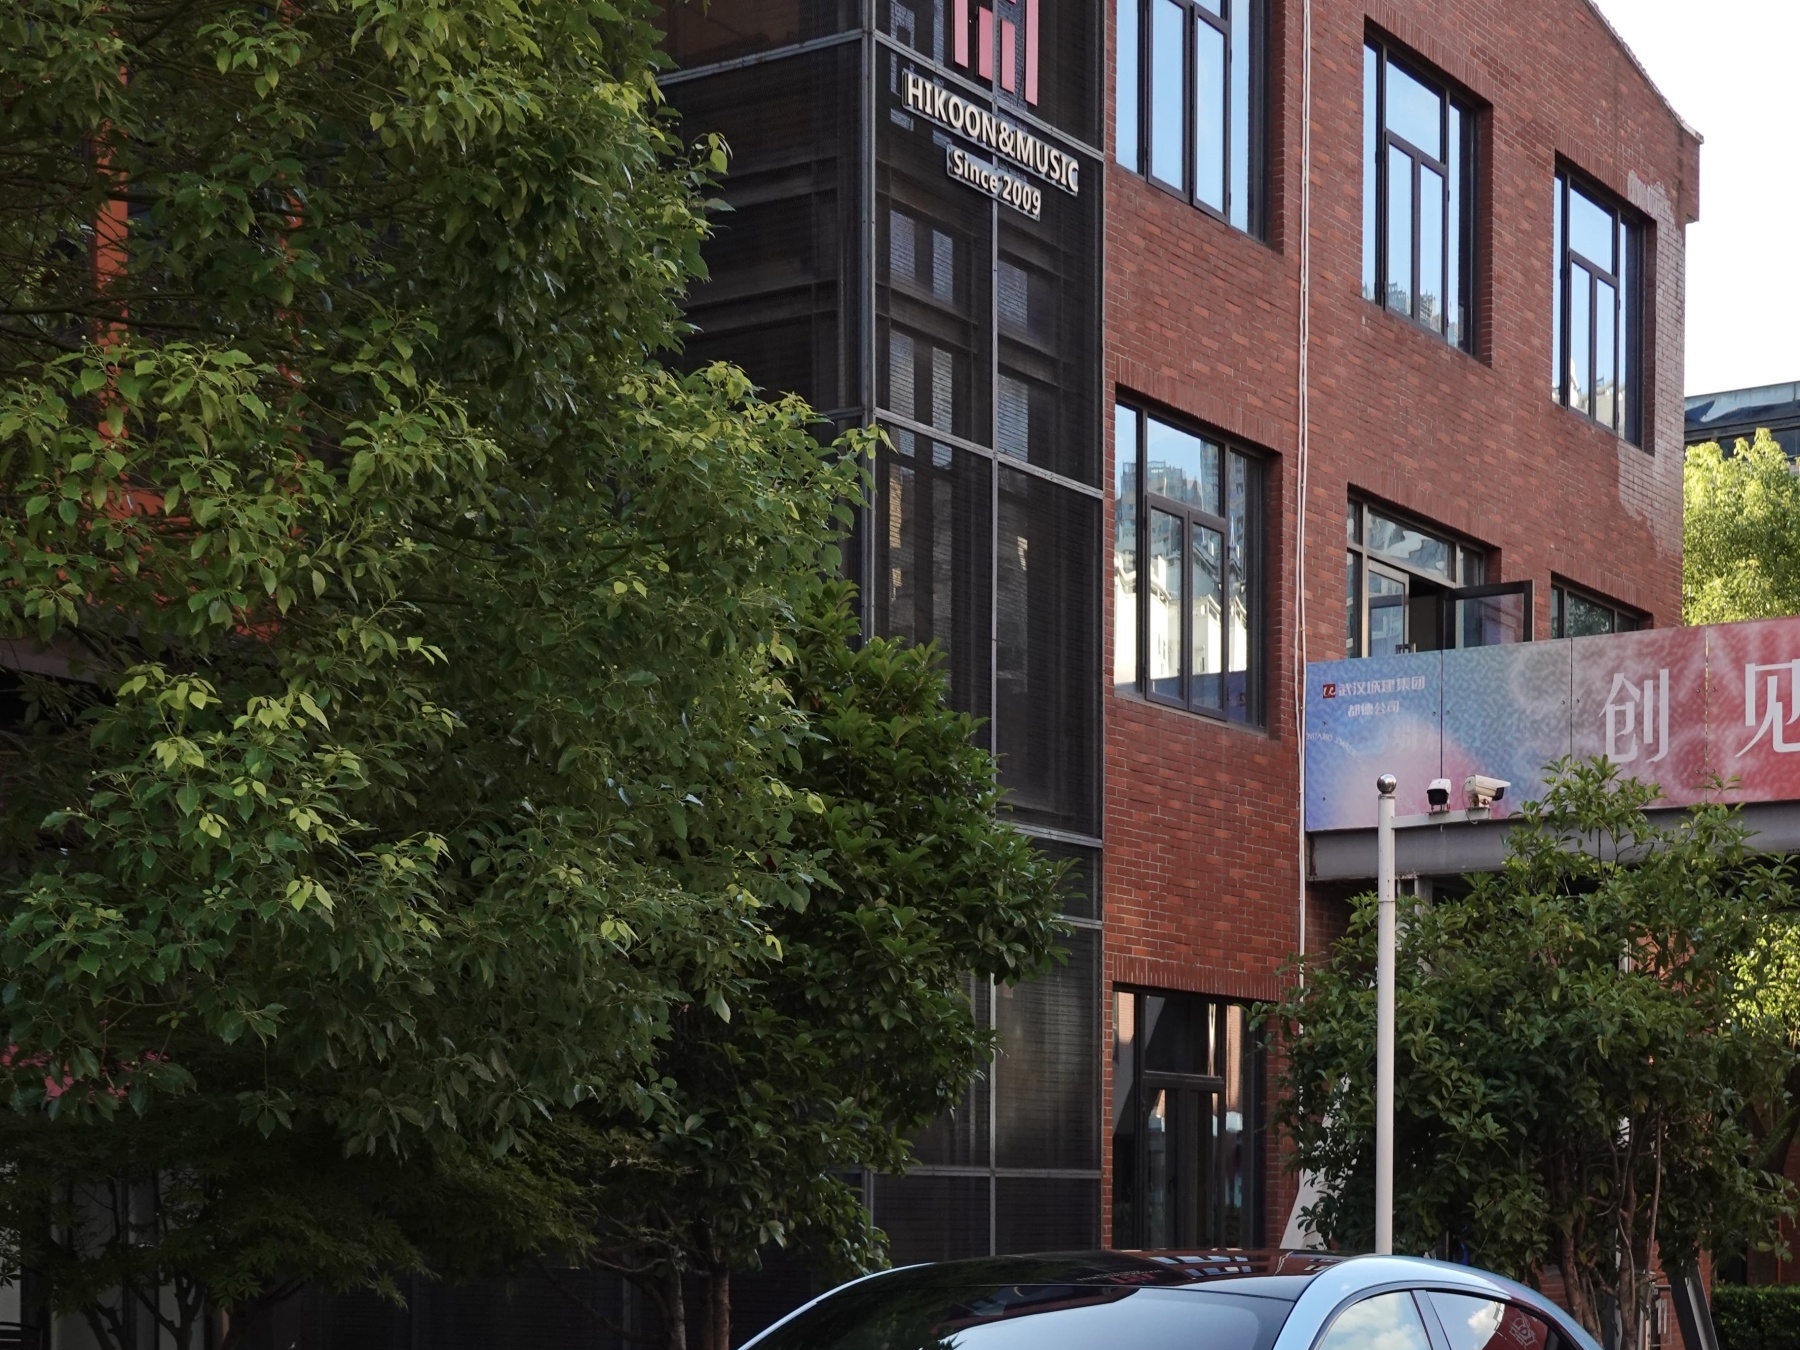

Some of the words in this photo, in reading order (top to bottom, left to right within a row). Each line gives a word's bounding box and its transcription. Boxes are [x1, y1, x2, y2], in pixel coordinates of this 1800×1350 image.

[906, 73, 1079, 192] HIKOON&MUSIC
[953, 150, 998, 194] Since
[1001, 176, 1041, 215] 2009
[1338, 676, 1425, 696] 武汉城建集团
